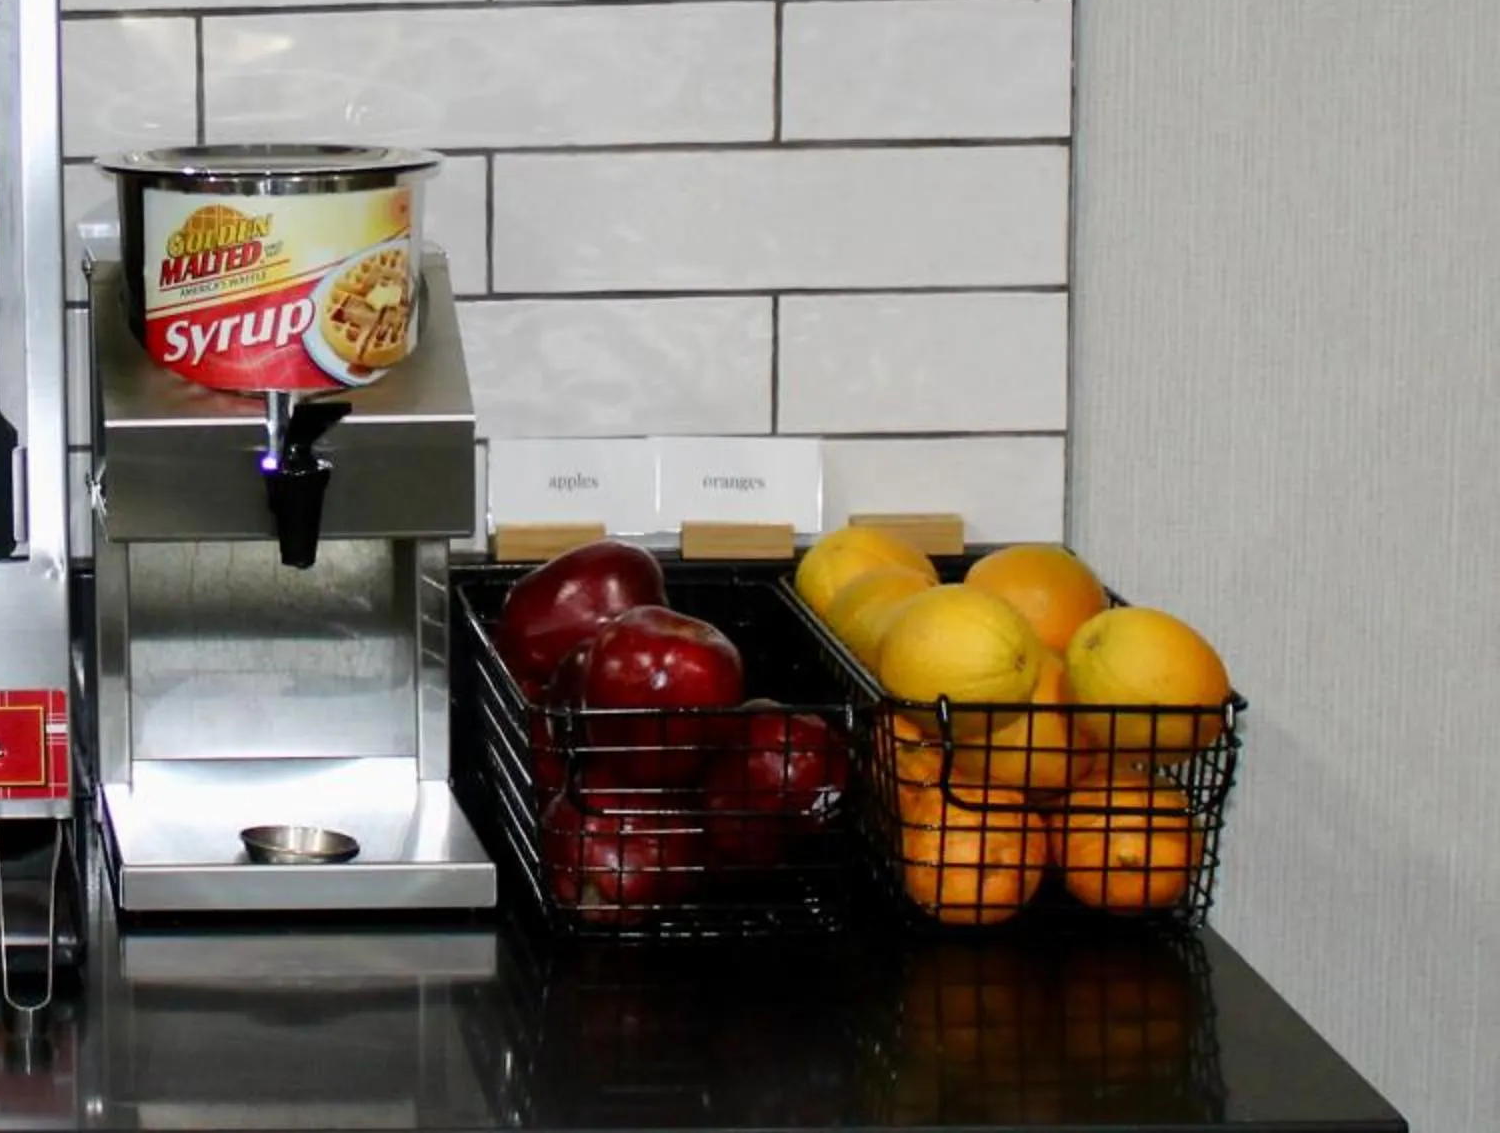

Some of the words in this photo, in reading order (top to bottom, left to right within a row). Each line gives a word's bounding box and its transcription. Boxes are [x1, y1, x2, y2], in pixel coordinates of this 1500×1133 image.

[166, 213, 274, 258] GOLDEN
[160, 240, 262, 287] MALTED
[163, 298, 314, 366] Syrup
[548, 473, 599, 491] apples
[702, 475, 766, 492] oranges
